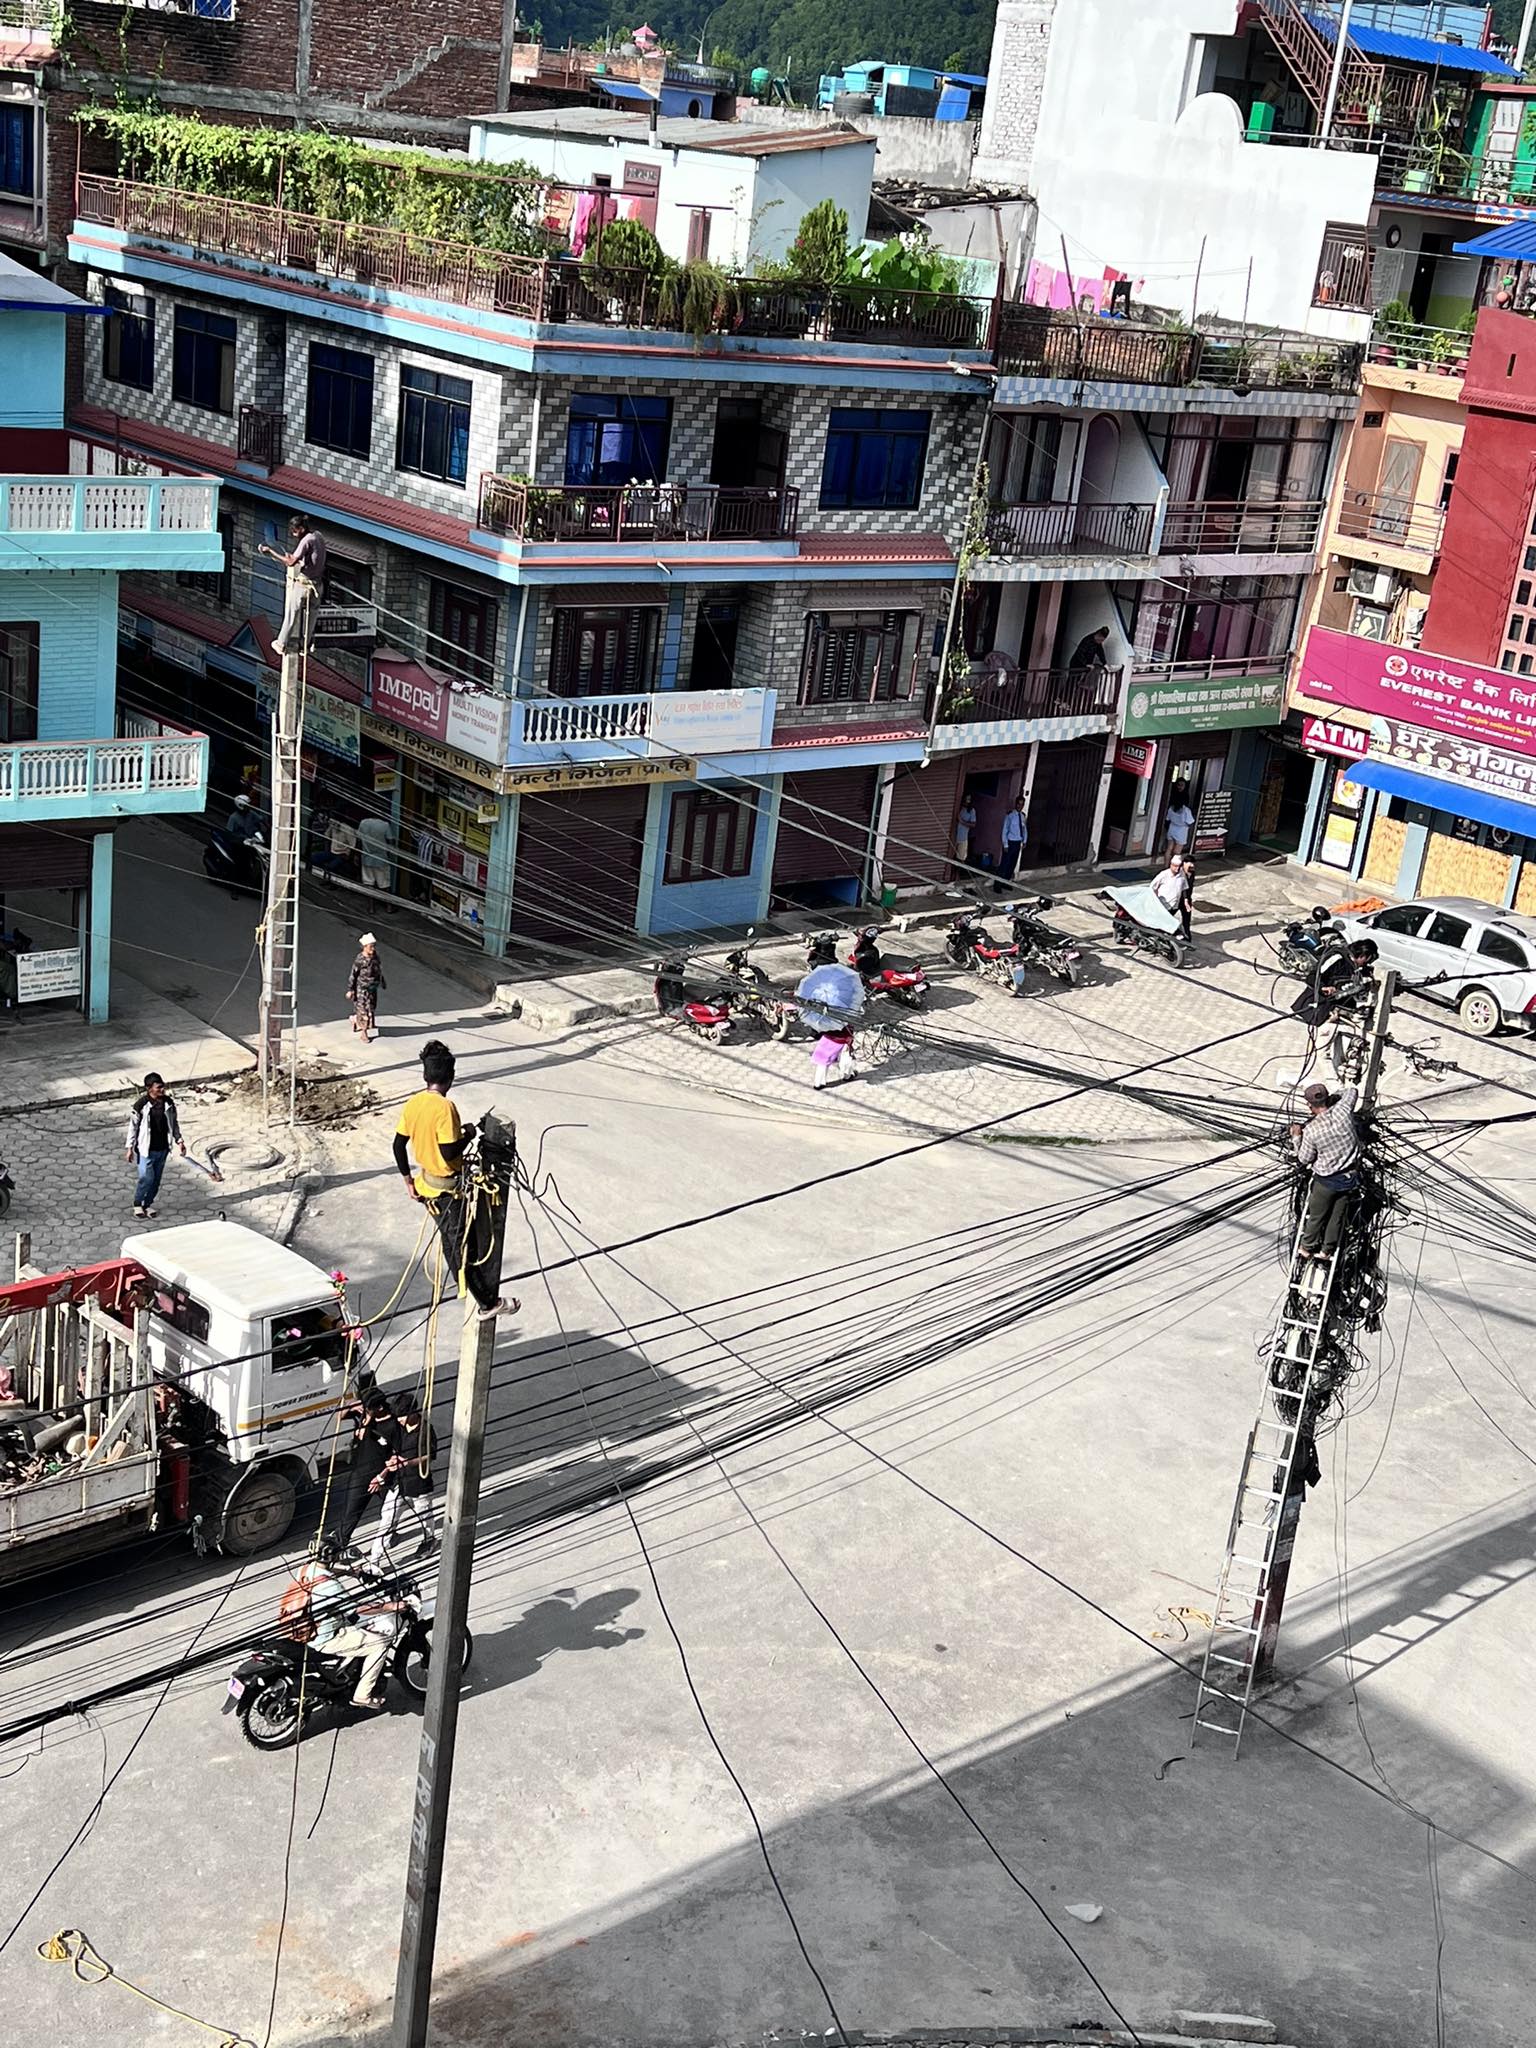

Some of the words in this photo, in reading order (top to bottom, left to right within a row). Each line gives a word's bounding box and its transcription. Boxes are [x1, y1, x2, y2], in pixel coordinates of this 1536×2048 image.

[378, 671, 441, 721] IMEpay
[1472, 677, 1503, 699] बैंक
[474, 705, 499, 723] VISION
[1380, 676, 1457, 706] EVEREST
[1460, 697, 1512, 721] BANK
[1514, 711, 1536, 728] LI
[1307, 719, 1366, 751] ATM
[1396, 727, 1445, 755] घर
[1127, 745, 1146, 760] IME
[272, 1398, 298, 1410] POWER
[297, 1388, 329, 1404] STEERING
